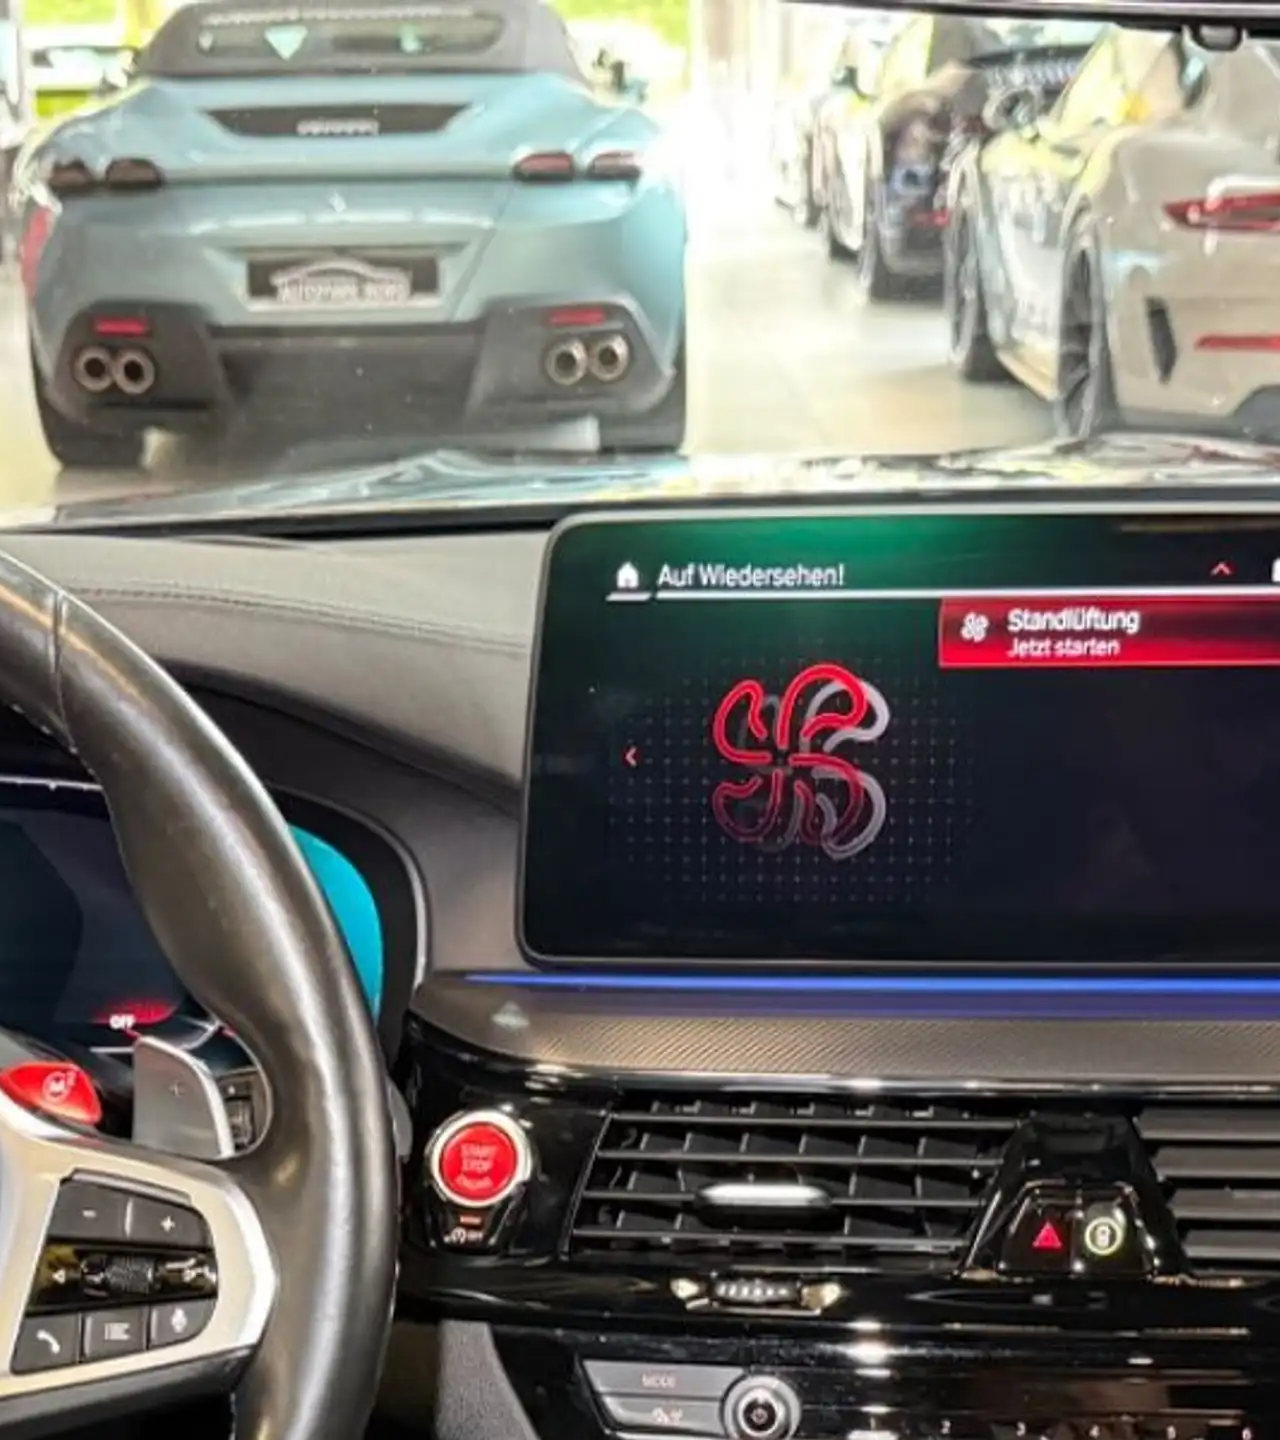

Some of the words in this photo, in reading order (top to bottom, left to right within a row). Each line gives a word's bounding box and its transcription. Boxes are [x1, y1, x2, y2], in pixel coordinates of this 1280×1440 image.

[657, 563, 694, 587] Auf
[699, 562, 845, 588] Wiedersehen!
[1007, 606, 1141, 635] Standlüftung
[1007, 637, 1050, 658] Jetzt
[1053, 638, 1120, 657] starten
